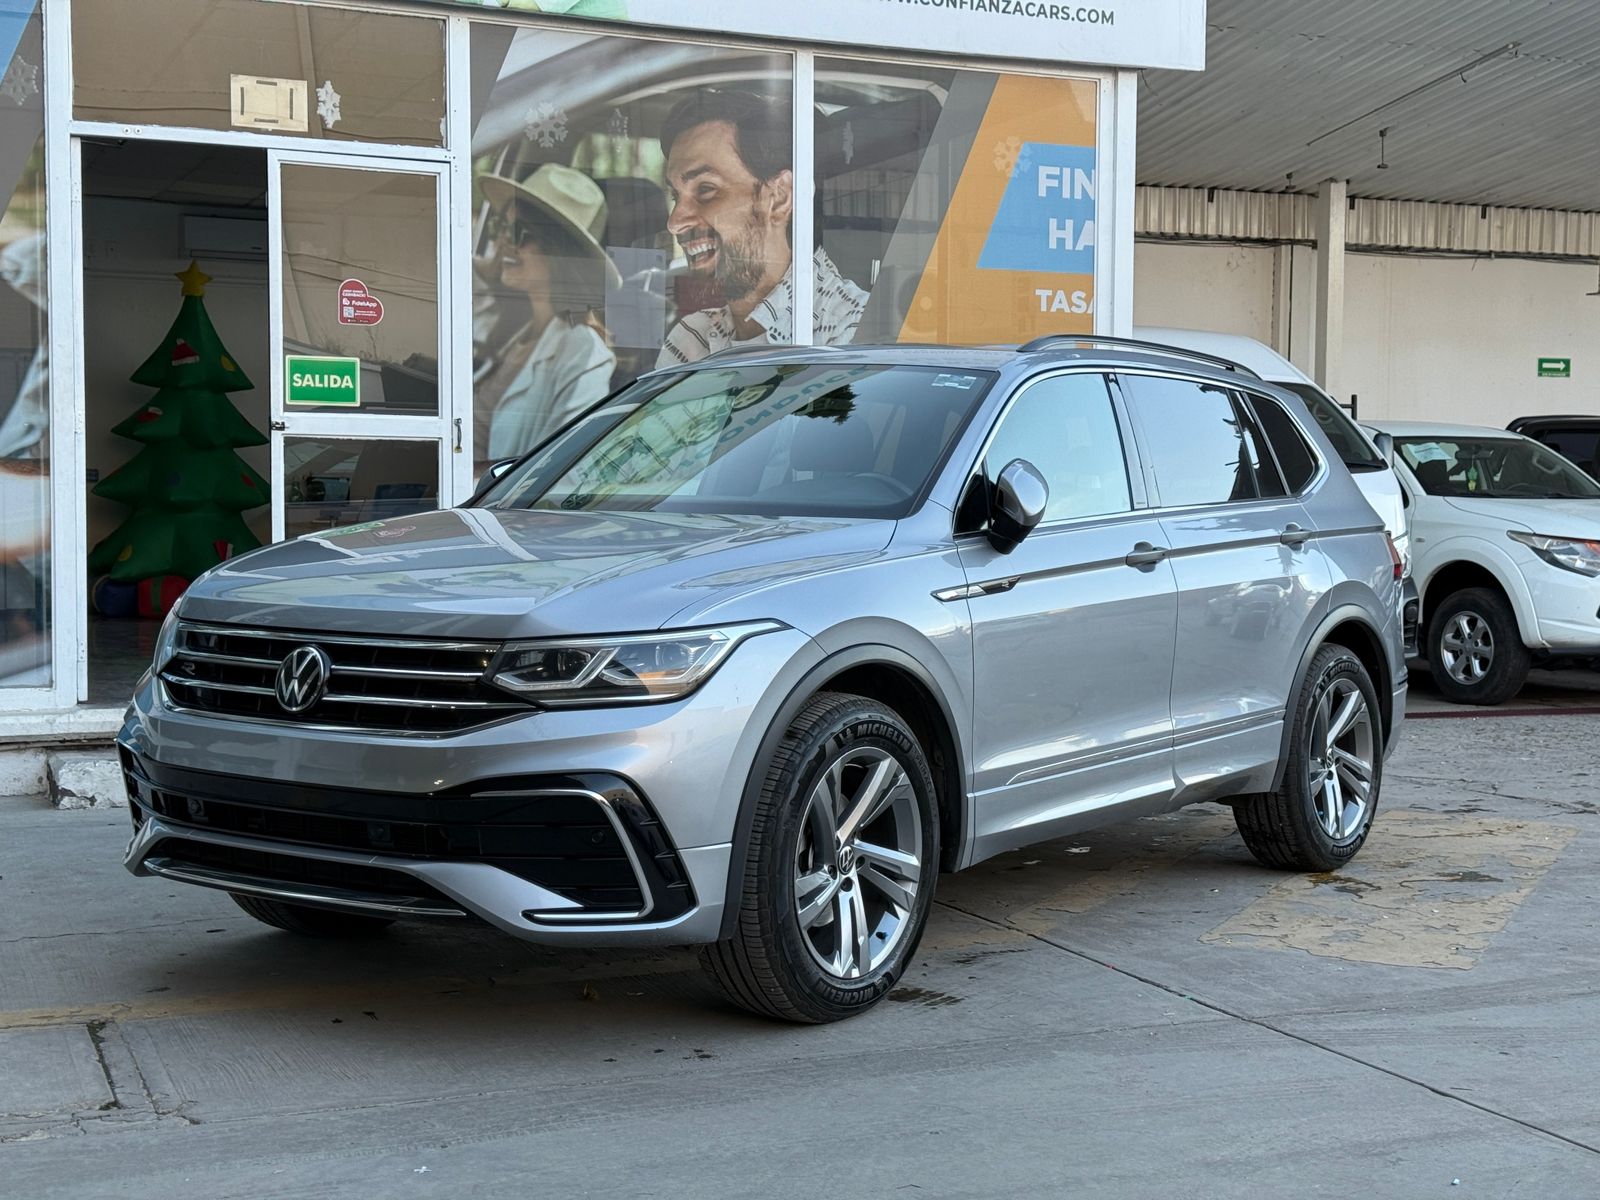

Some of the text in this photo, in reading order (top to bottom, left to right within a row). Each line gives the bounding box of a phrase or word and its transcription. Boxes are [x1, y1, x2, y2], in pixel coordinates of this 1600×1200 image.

[1038, 165, 1095, 200] FIN
[1035, 288, 1094, 314] TAS
[292, 373, 354, 389] SALIDA
[856, 722, 913, 753] MICHELIN
